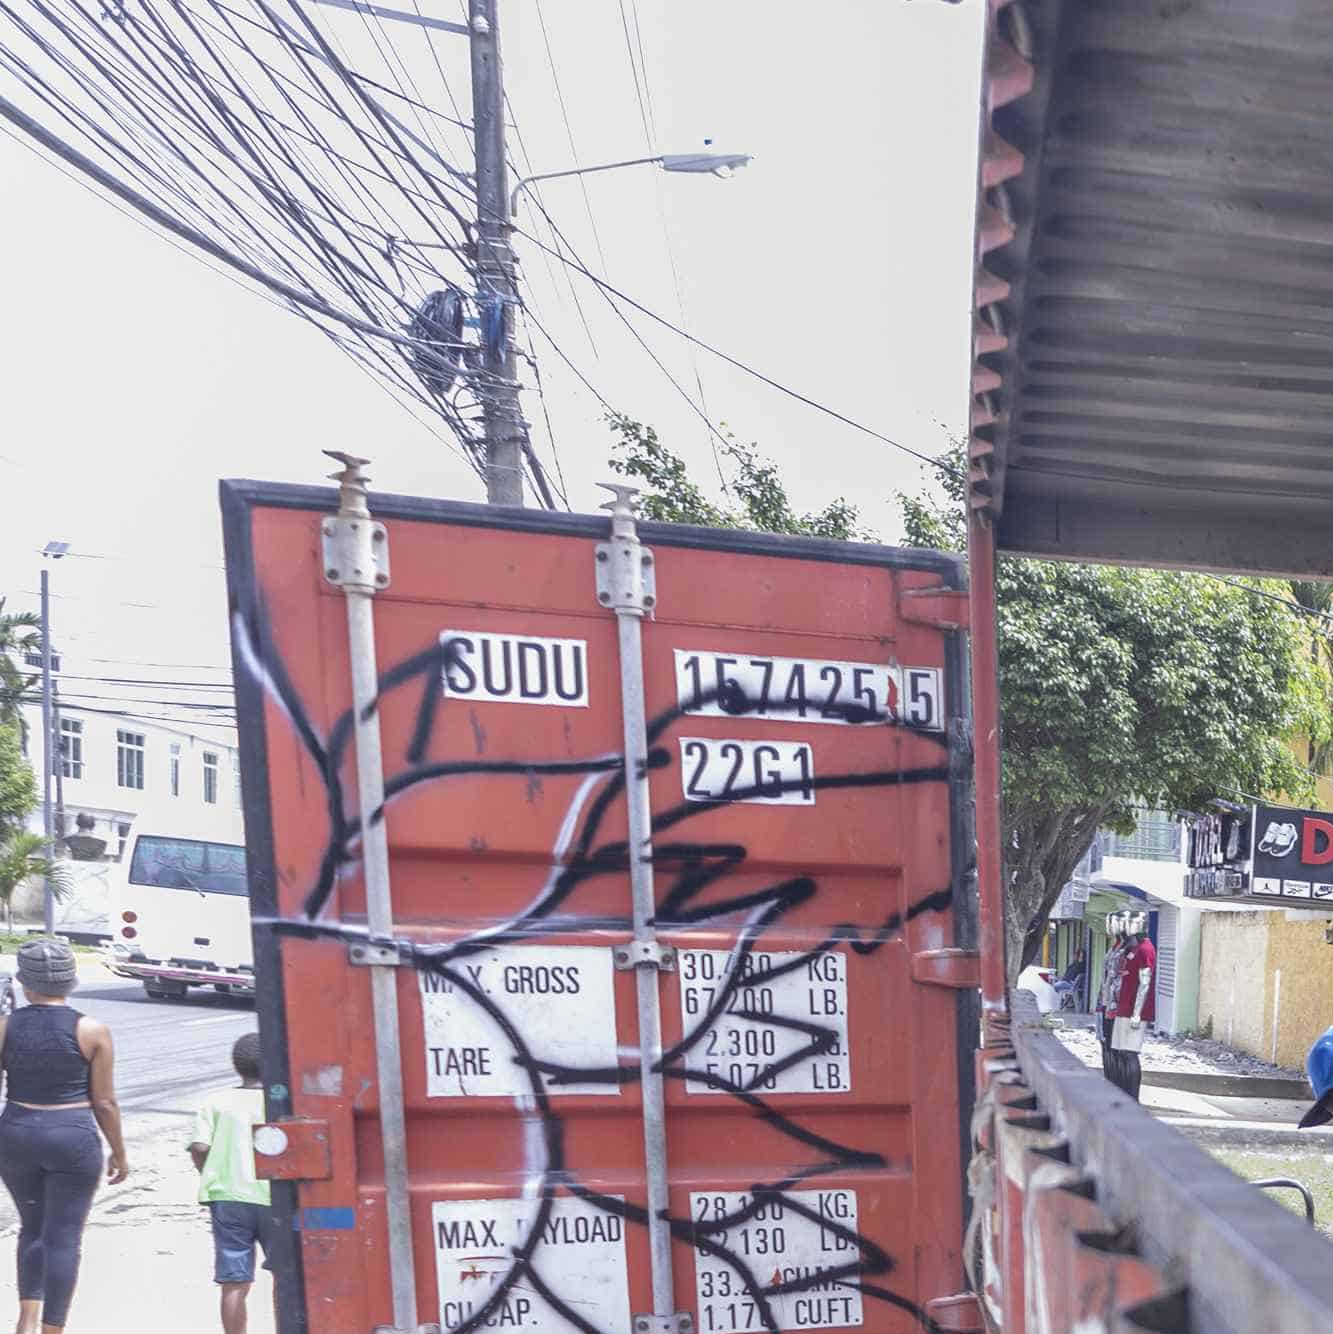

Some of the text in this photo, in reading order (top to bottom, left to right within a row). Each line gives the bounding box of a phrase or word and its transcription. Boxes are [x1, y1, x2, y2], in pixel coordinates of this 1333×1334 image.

[446, 637, 585, 700] SUDU
[909, 671, 933, 727] 5
[685, 742, 811, 801] 22G1
[424, 964, 580, 994] MX. GROSS
[808, 955, 844, 982] KG.
[685, 988, 844, 1016] 67200 LB.
[706, 1029, 848, 1057] 2.300 G.
[430, 1048, 492, 1076] TARE
[812, 1063, 848, 1090] LB.
[819, 1192, 855, 1219] KG.
[437, 1215, 622, 1249] MAX. YLOAD
